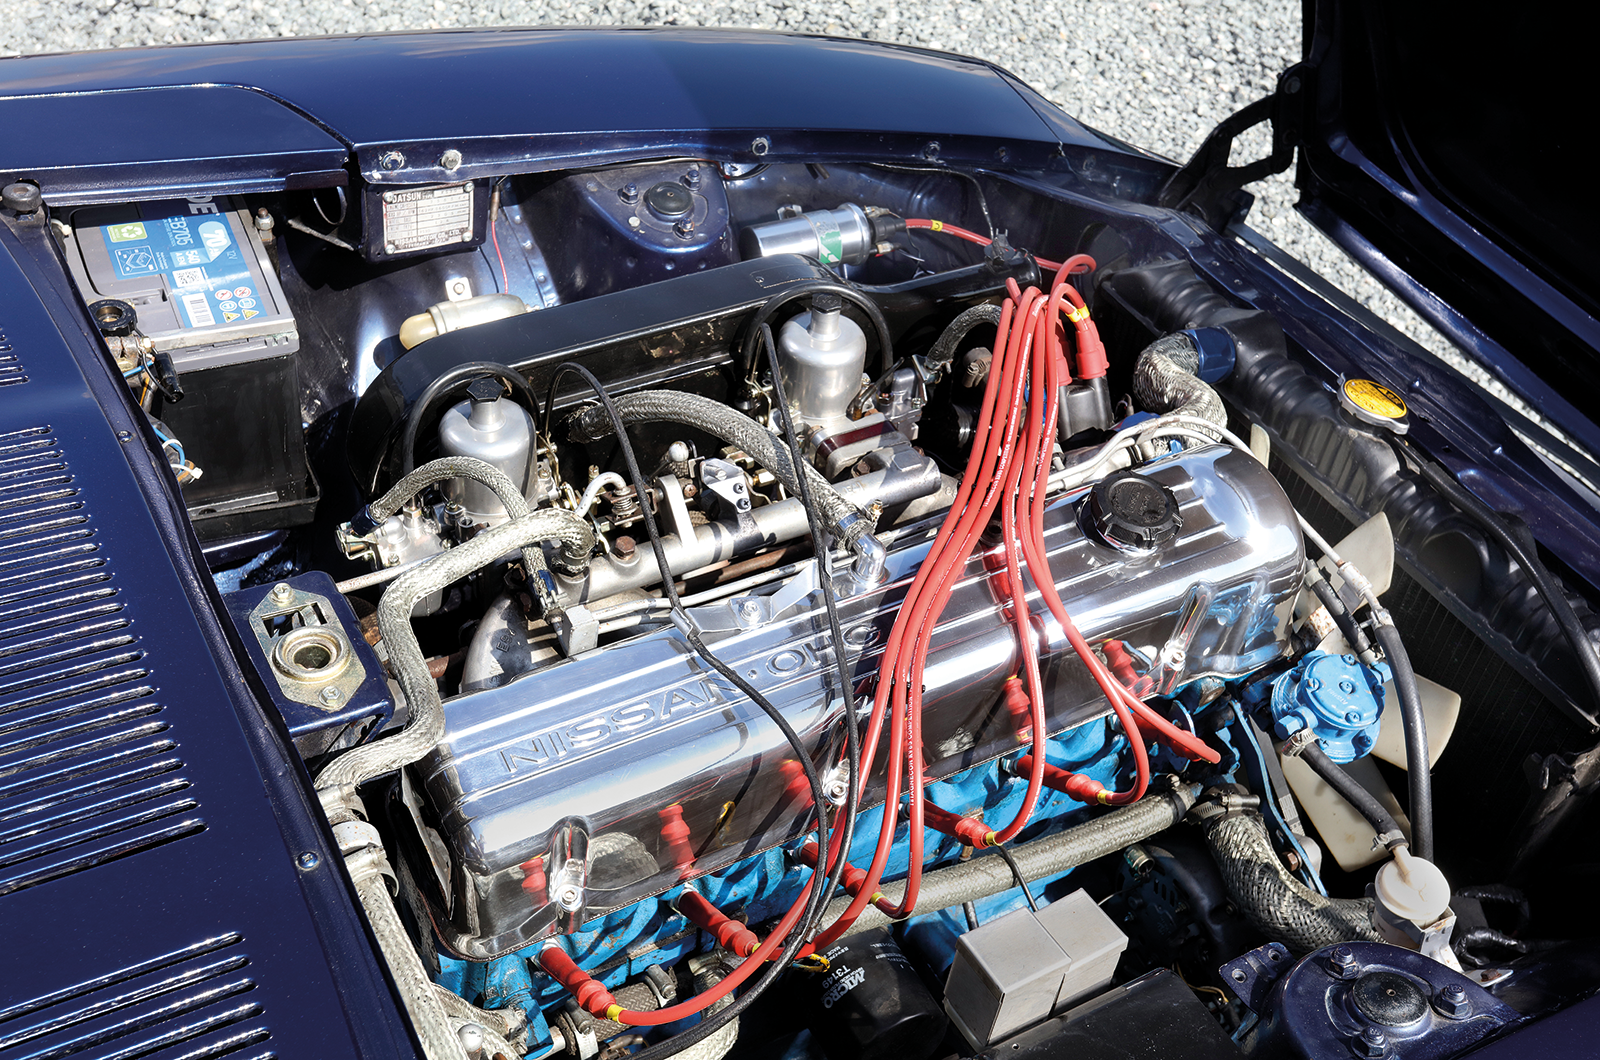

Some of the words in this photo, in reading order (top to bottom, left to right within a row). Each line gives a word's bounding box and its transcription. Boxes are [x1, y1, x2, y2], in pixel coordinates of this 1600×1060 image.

[168, 216, 193, 246] EB705
[203, 229, 226, 247] 70
[185, 250, 200, 263] 540
[226, 250, 237, 260] 12V
[499, 678, 741, 773] NISSAN
[823, 965, 851, 989] T3149
[824, 969, 866, 1009] MICRO
